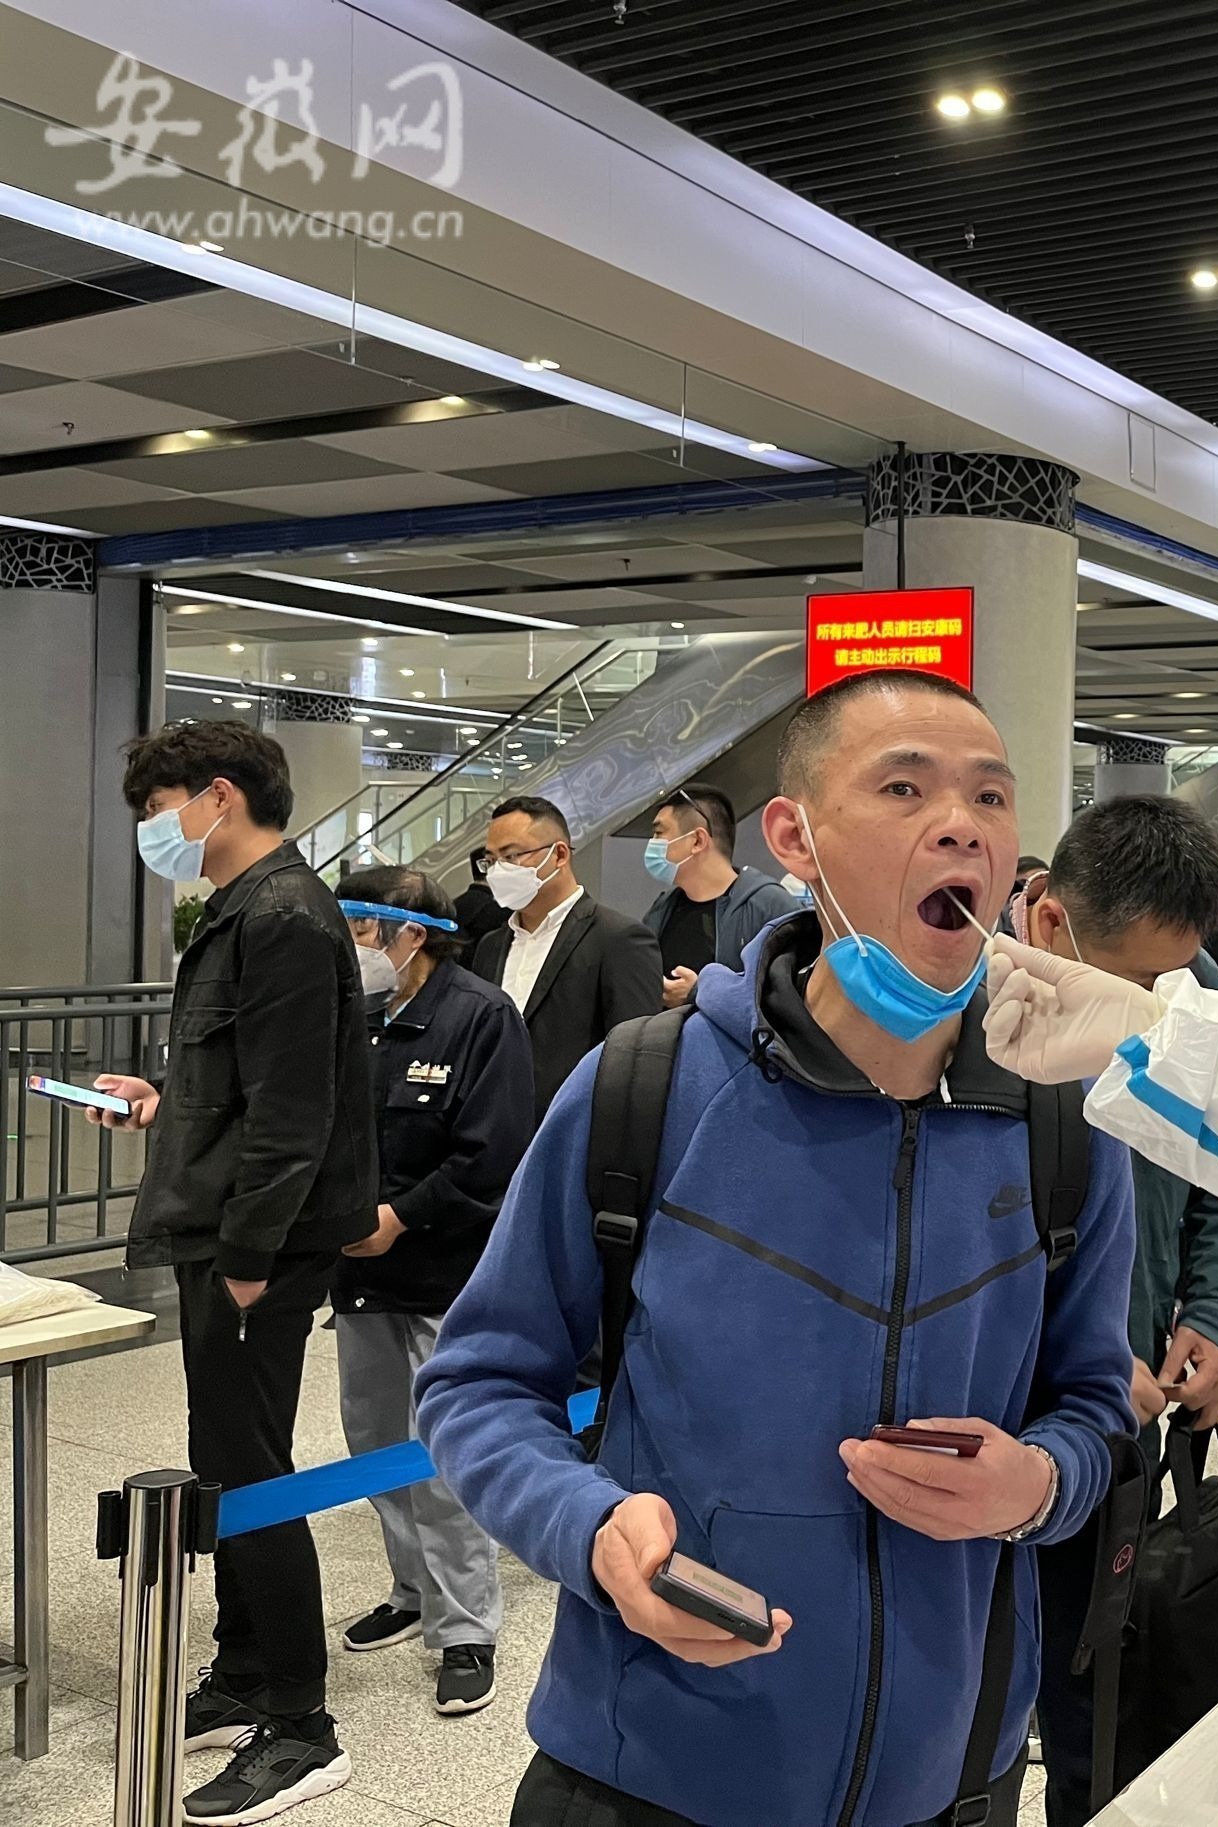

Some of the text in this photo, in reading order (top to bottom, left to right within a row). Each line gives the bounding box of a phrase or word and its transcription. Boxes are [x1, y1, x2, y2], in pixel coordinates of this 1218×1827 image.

[816, 618, 963, 641] 所有来肥人员请扫安康码
[834, 645, 942, 666] 请主动出示行程码
